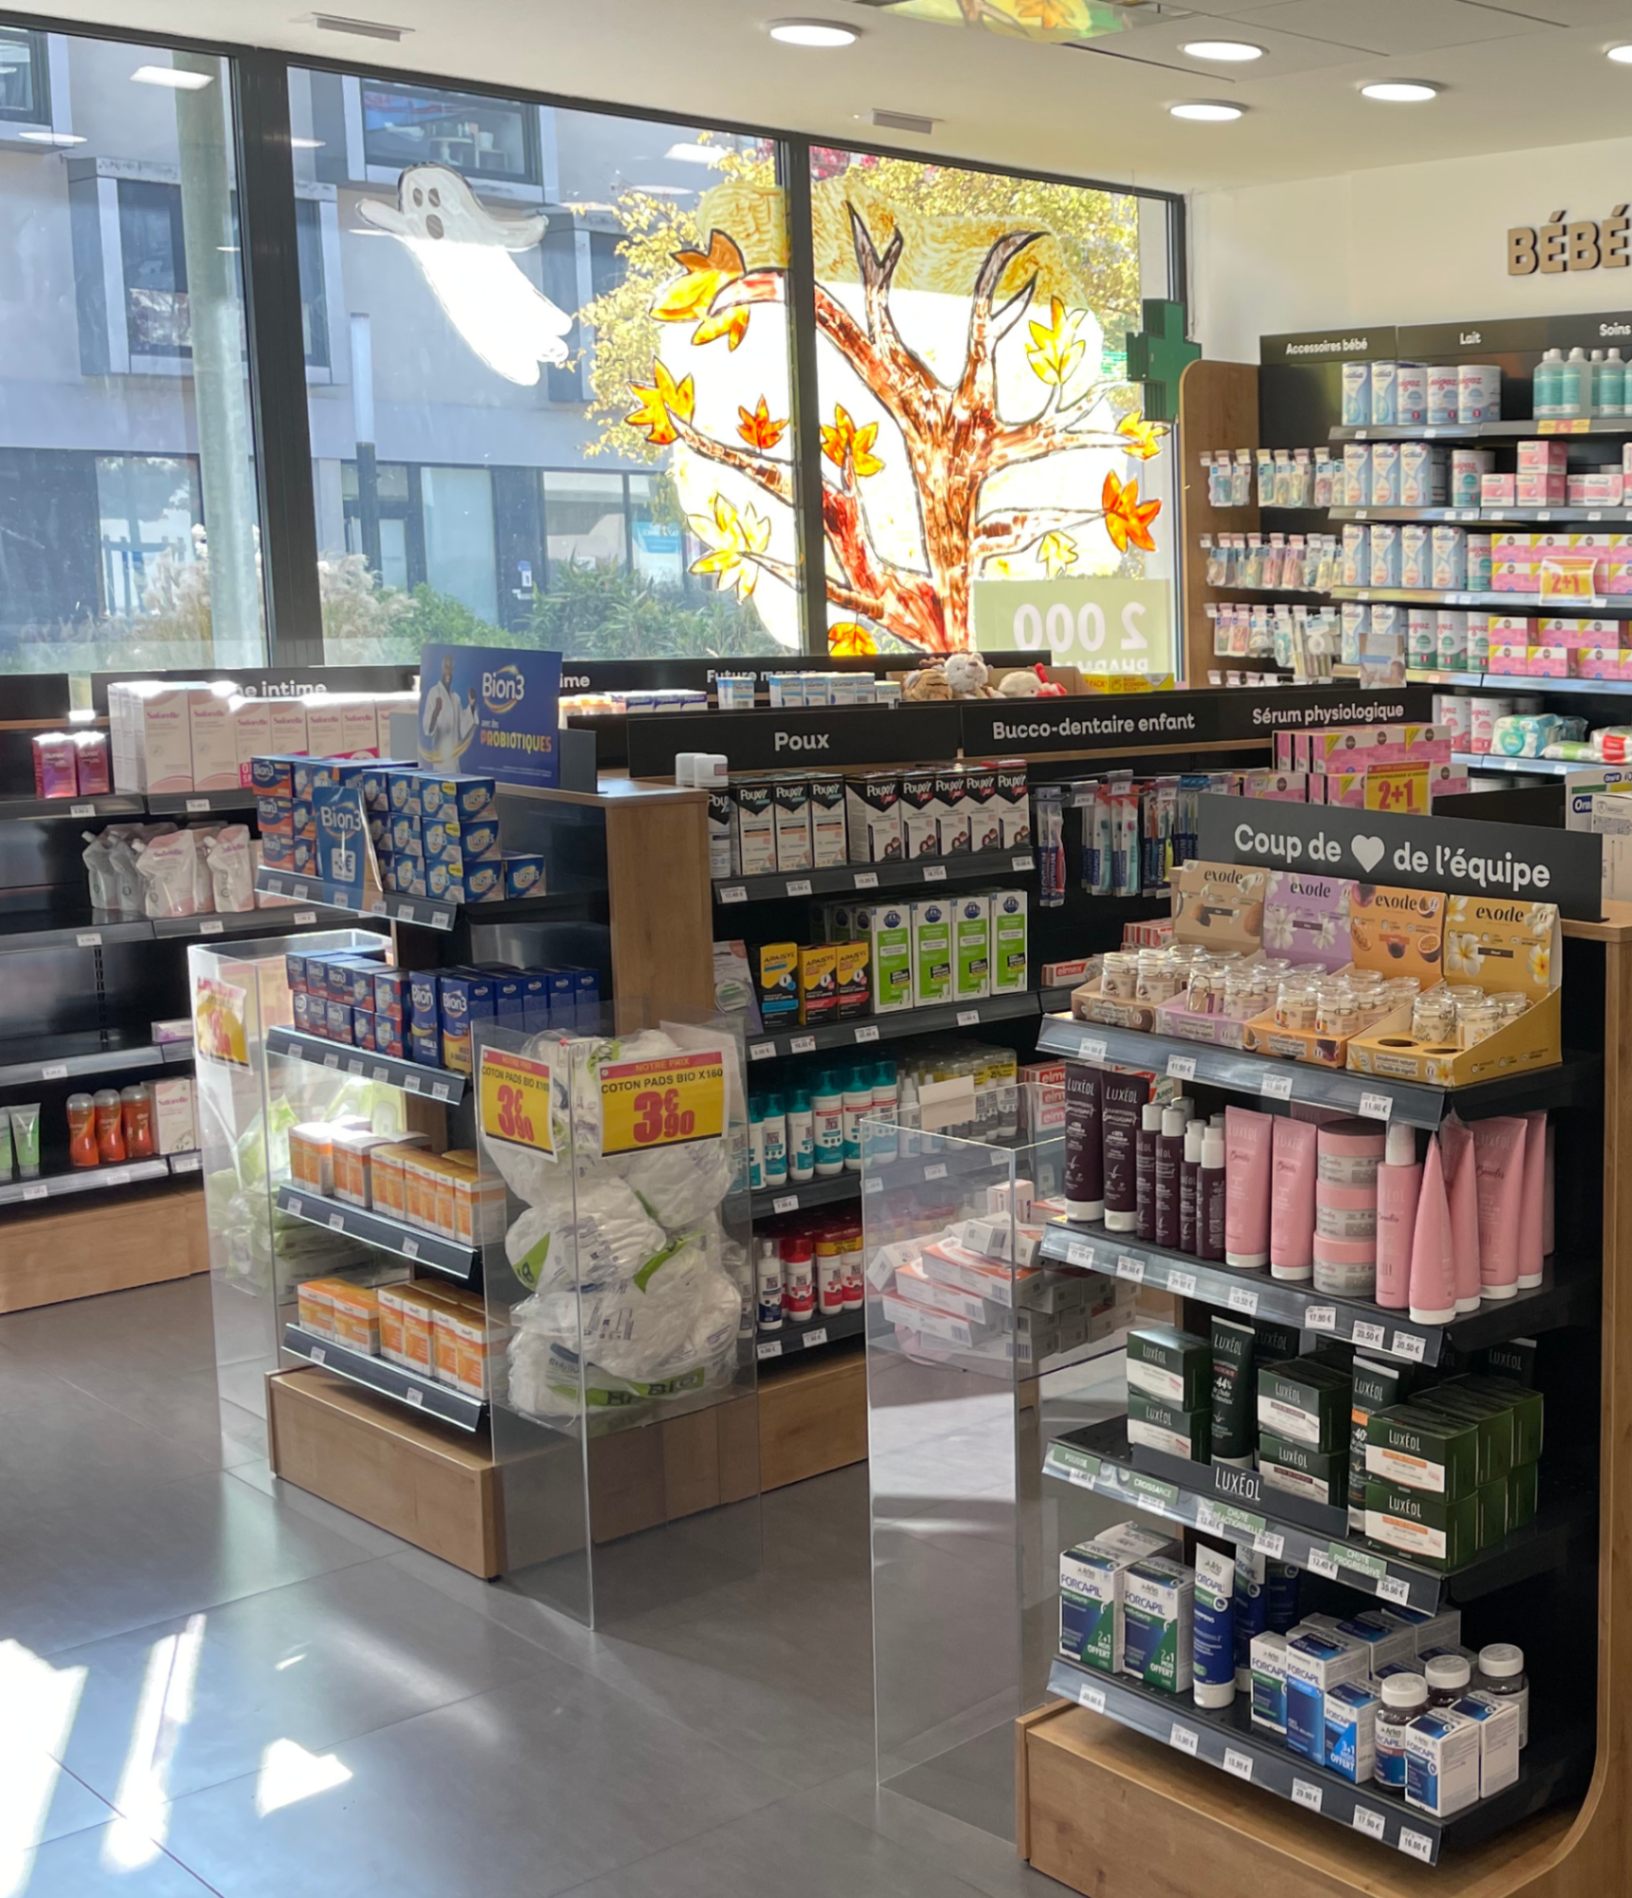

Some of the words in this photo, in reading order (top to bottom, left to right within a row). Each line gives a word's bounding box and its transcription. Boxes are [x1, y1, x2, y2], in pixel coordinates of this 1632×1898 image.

[1507, 204, 1631, 276] BÉBÉ
[1459, 331, 1482, 345] Lait
[1600, 322, 1631, 337] Soins
[1286, 339, 1341, 355] Accessoires
[1343, 337, 1368, 351] bébé
[261, 680, 328, 698] intime
[482, 672, 525, 700] Bion3
[1252, 706, 1301, 726] Sérum
[1305, 701, 1404, 727] physiologique
[992, 715, 1135, 740] Bucco-dentaire
[1138, 712, 1196, 734] enfant
[480, 729, 552, 754] PROBIOTIQUES
[774, 731, 830, 752] Poux
[1378, 778, 1414, 810] 2+1
[1574, 799, 1592, 811] Ora
[320, 804, 362, 831] Bion3
[1234, 823, 1303, 863] Coup
[1308, 830, 1342, 863] de
[1393, 841, 1430, 873] de
[1435, 844, 1552, 893] l'équipe
[1203, 869, 1243, 885] exode
[1290, 882, 1332, 898] exode
[1375, 895, 1418, 911] exode
[1476, 904, 1525, 922] exode
[601, 1078, 638, 1095] COTON
[643, 1076, 674, 1089] PADS
[677, 1072, 696, 1084] BIO
[1041, 1071, 1066, 1084] elm
[1067, 1077, 1095, 1096] LUXÉOL
[1106, 1086, 1138, 1105] LUXÉOL
[1042, 1110, 1066, 1124] elm
[1214, 1334, 1242, 1356] LUXÉOL
[1275, 1382, 1300, 1402] LUXÉOL
[1354, 1377, 1383, 1401] LUXÉOL
[1146, 1406, 1172, 1426] LUXÉOL
[1389, 1429, 1421, 1451] LUXÉOL
[1279, 1447, 1308, 1468] LUXÉOL
[1215, 1467, 1261, 1500] LUXÉOL
[1389, 1495, 1422, 1518] LUXÉOL
[1061, 1574, 1102, 1598] FORCAPIL
[1125, 1591, 1165, 1616] FORCAPIL
[1149, 1663, 1175, 1679] OFFERT
[1287, 1662, 1320, 1685] FORCAPIL
[1407, 1740, 1436, 1760] FORCAPIL
[1330, 1755, 1355, 1772] OFFERT
